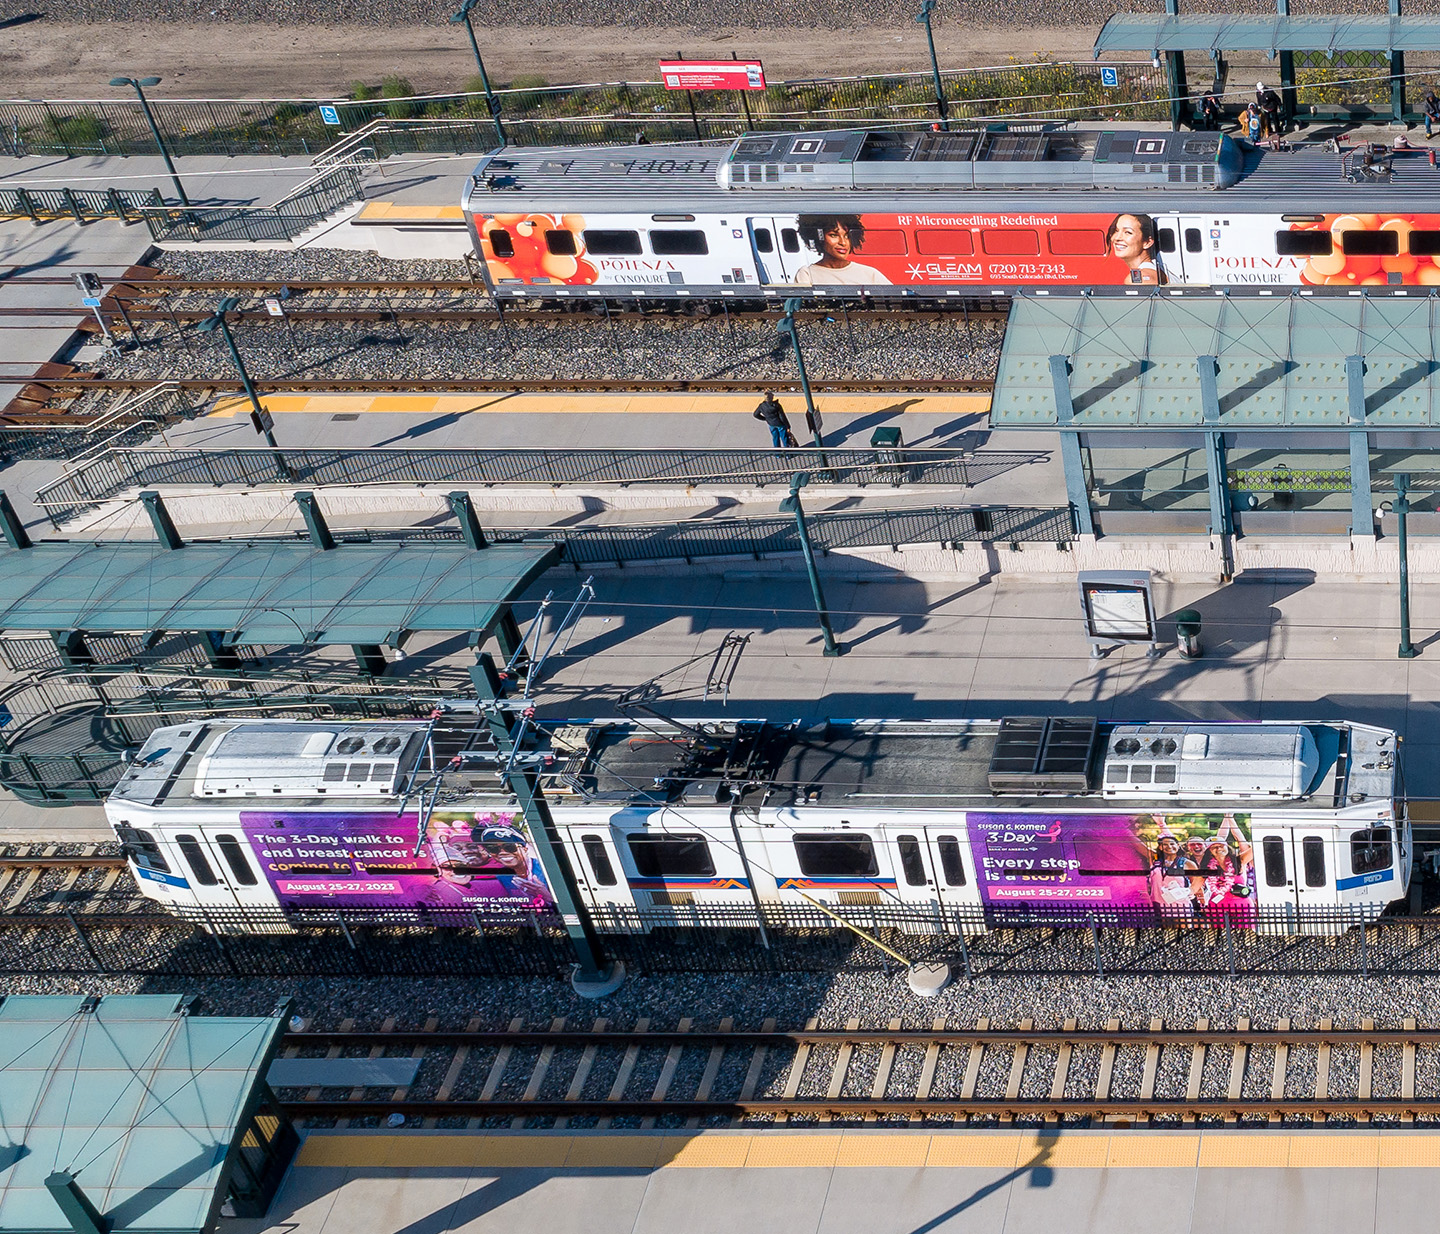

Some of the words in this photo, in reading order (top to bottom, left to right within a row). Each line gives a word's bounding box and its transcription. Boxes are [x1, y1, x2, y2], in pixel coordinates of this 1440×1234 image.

[638, 159, 711, 174] 4041
[898, 215, 912, 226] RF
[915, 215, 998, 227] Microneedling
[1000, 215, 1058, 226] Redefined
[600, 260, 675, 270] POTENZA
[1214, 256, 1297, 268] POTENZA
[926, 263, 982, 273] GLEAM
[988, 263, 1018, 274] (720)
[1018, 263, 1066, 274] 713-7343
[614, 274, 665, 283] CYNOSURE
[1226, 273, 1284, 283] CYNOSURE
[254, 834, 287, 844] The
[289, 834, 338, 846] 3-Day
[342, 835, 382, 844] walk
[385, 835, 404, 844] to
[261, 848, 295, 858] end
[298, 848, 350, 858] breast
[354, 849, 408, 858] cancer
[982, 857, 1034, 869] Every
[1040, 857, 1081, 870] step
[985, 869, 1000, 881] is
[286, 883, 326, 891] August
[328, 883, 364, 891] 25-27,
[365, 883, 395, 891] 2023
[996, 889, 1036, 898] August
[1038, 889, 1073, 897] 25-27,
[1075, 889, 1104, 897] 2023
